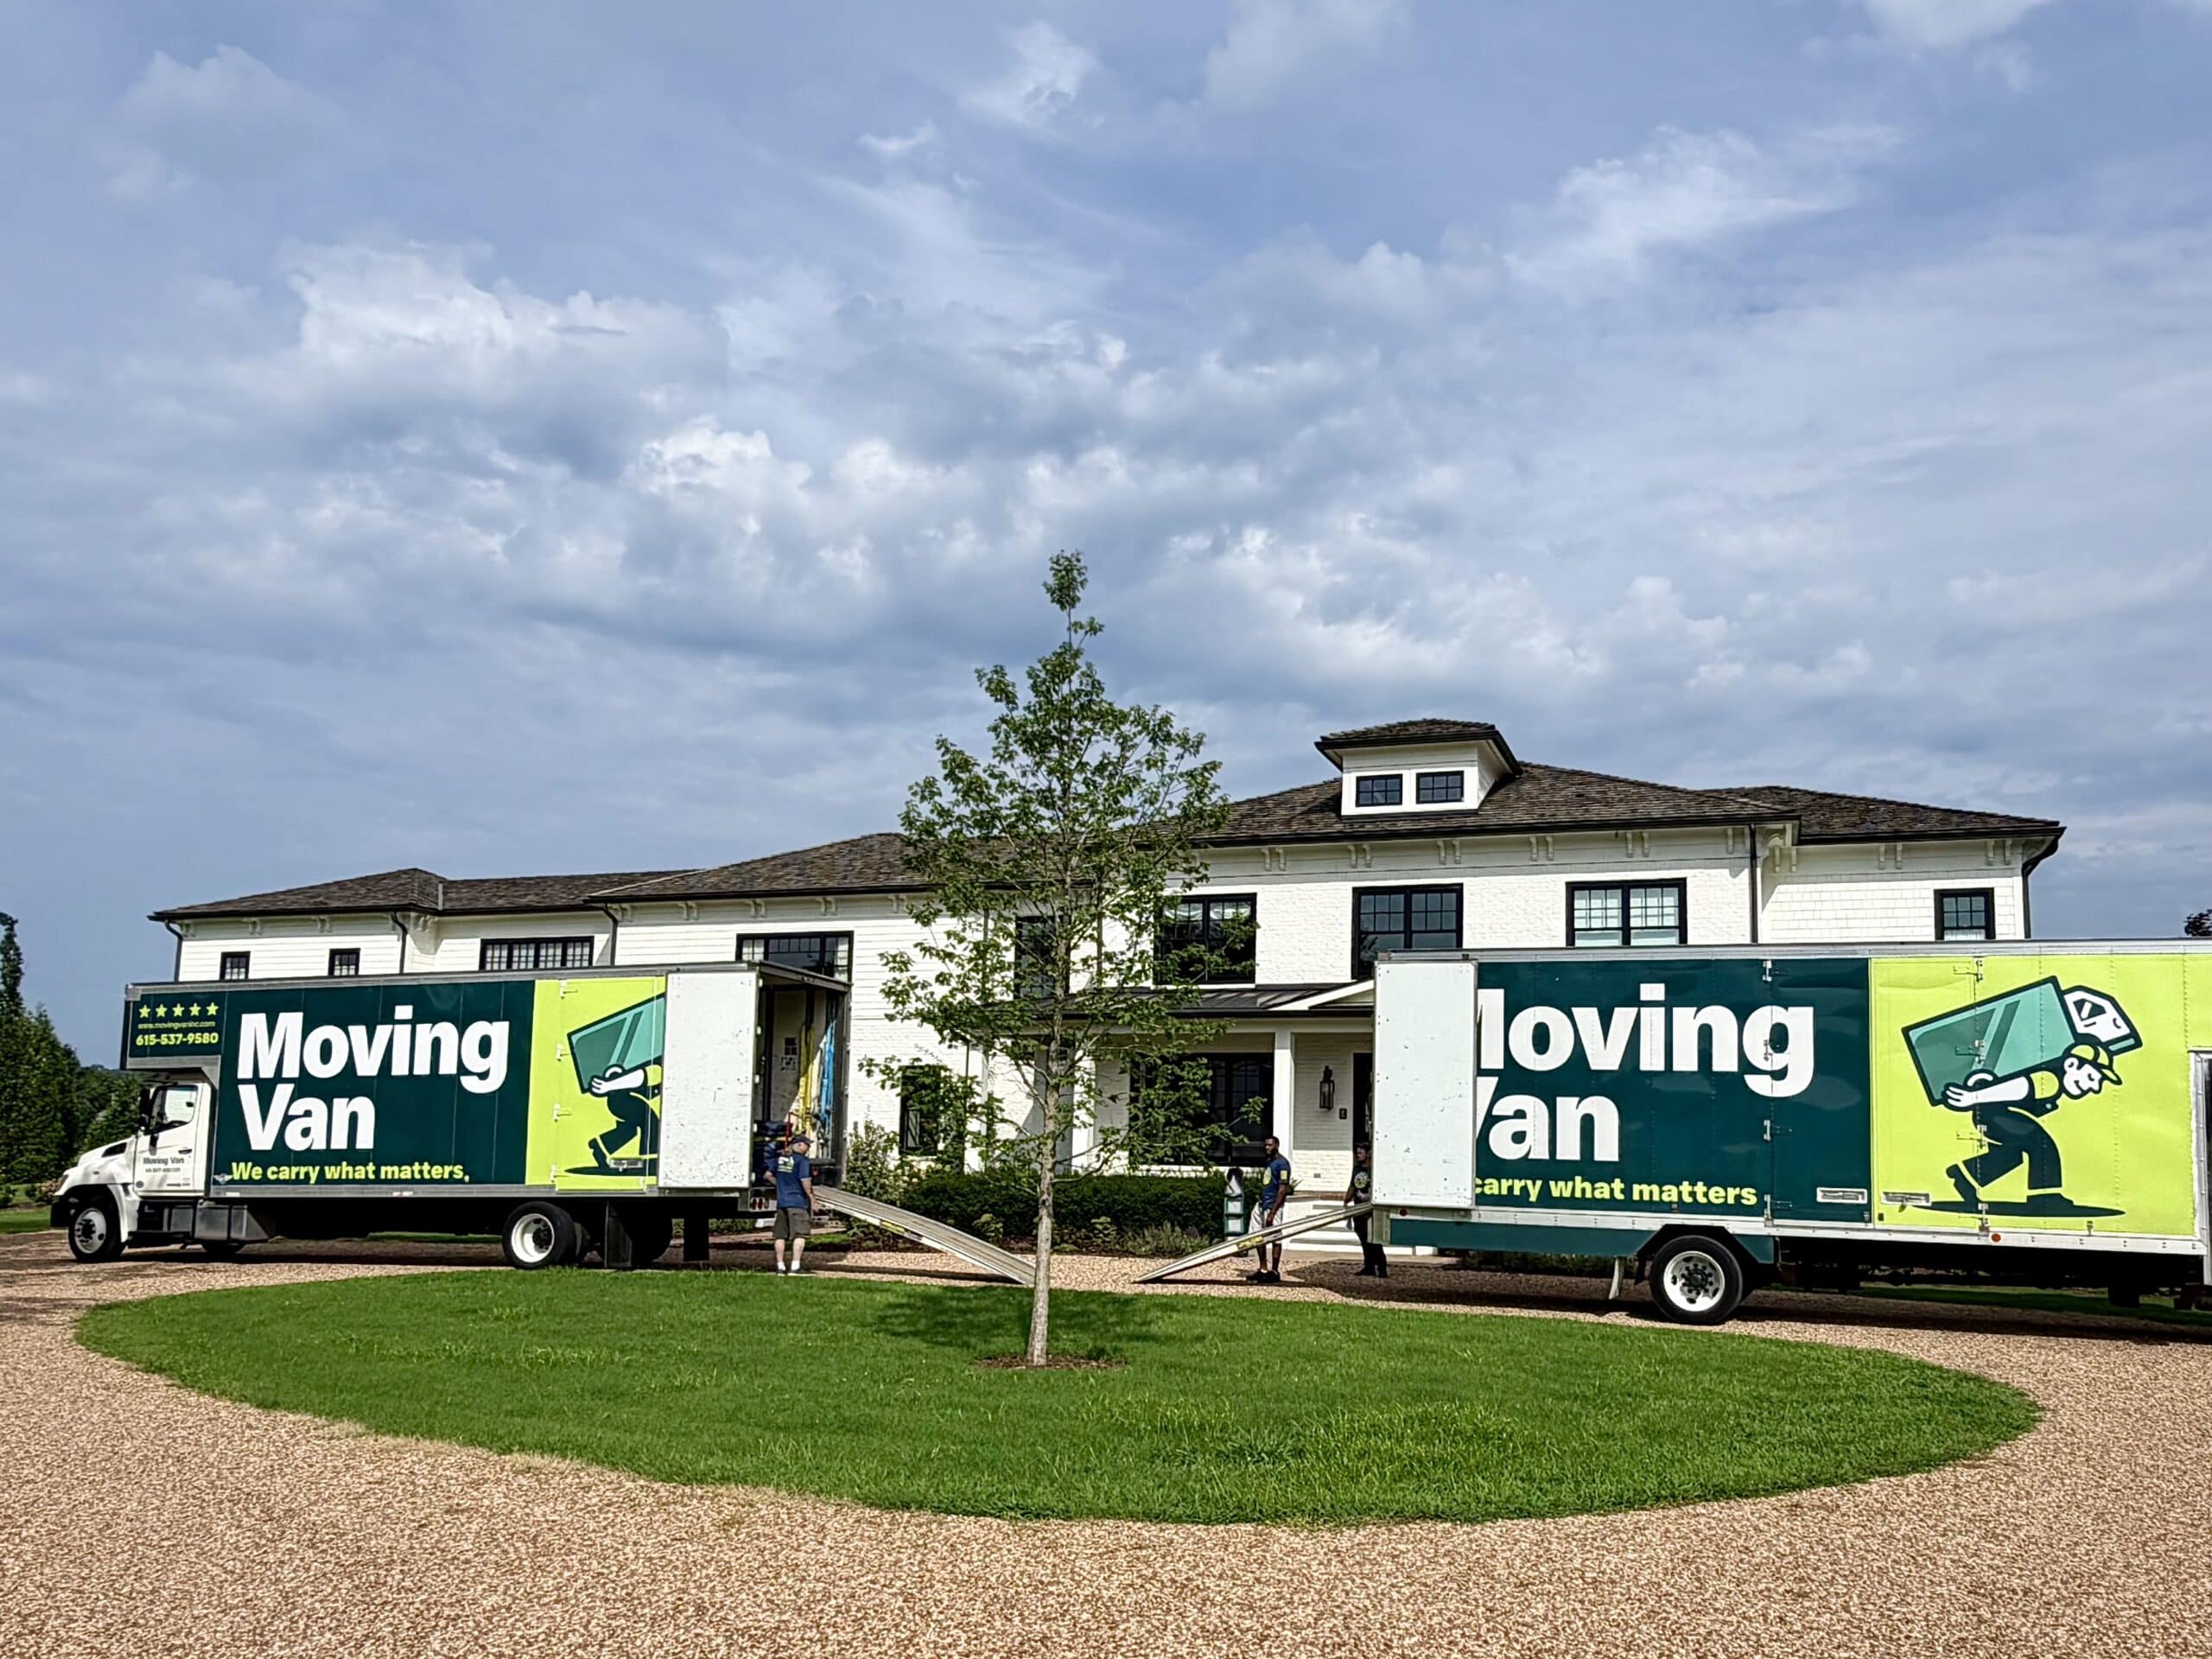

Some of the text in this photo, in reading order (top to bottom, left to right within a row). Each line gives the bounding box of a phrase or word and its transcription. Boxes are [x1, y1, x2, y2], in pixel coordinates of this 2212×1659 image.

[136, 1033, 219, 1046] 615-537-9580
[237, 1005, 510, 1094] Moving
[238, 1083, 376, 1152] Van
[232, 1161, 263, 1180] We
[267, 1166, 320, 1184] carry
[324, 1160, 376, 1179] what
[1549, 1176, 1624, 1199] what
[1632, 1180, 1758, 1205] matters
